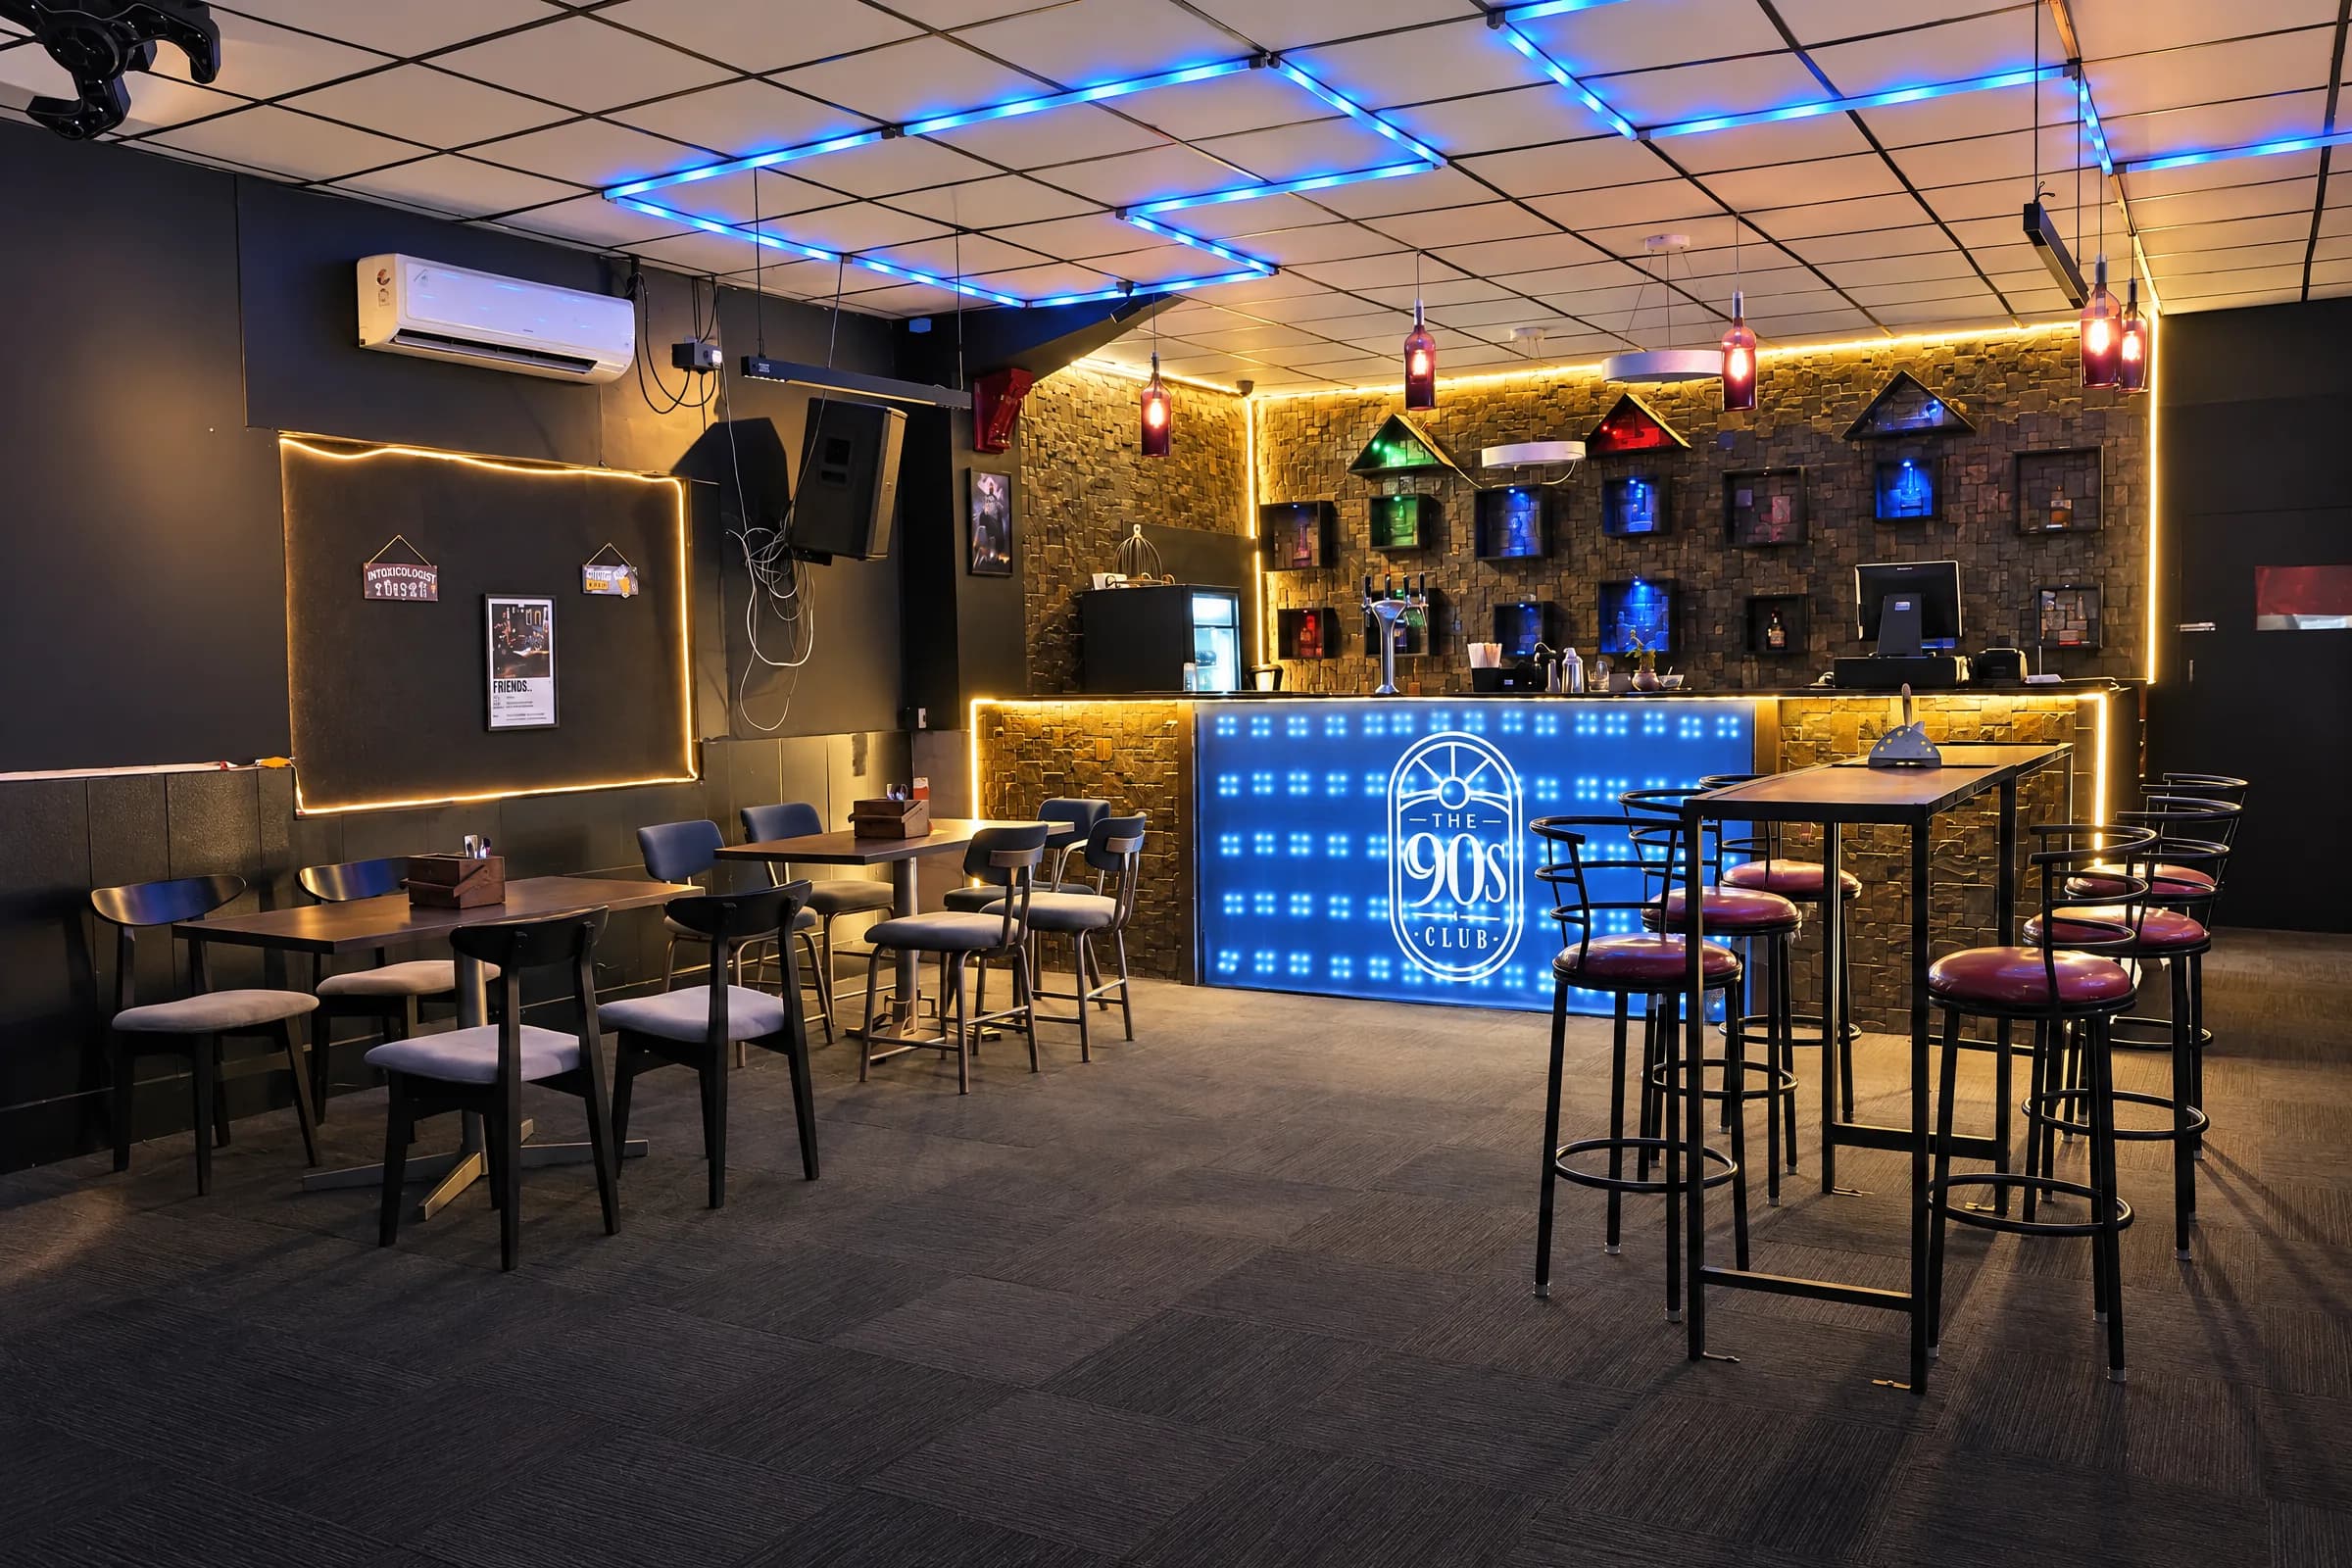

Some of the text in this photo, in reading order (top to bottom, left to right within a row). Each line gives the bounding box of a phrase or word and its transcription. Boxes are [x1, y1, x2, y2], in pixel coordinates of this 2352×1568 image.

[368, 566, 436, 584] INTOXICOLOGIST
[1432, 812, 1477, 829] THE
[1425, 926, 1489, 950] CLUB
